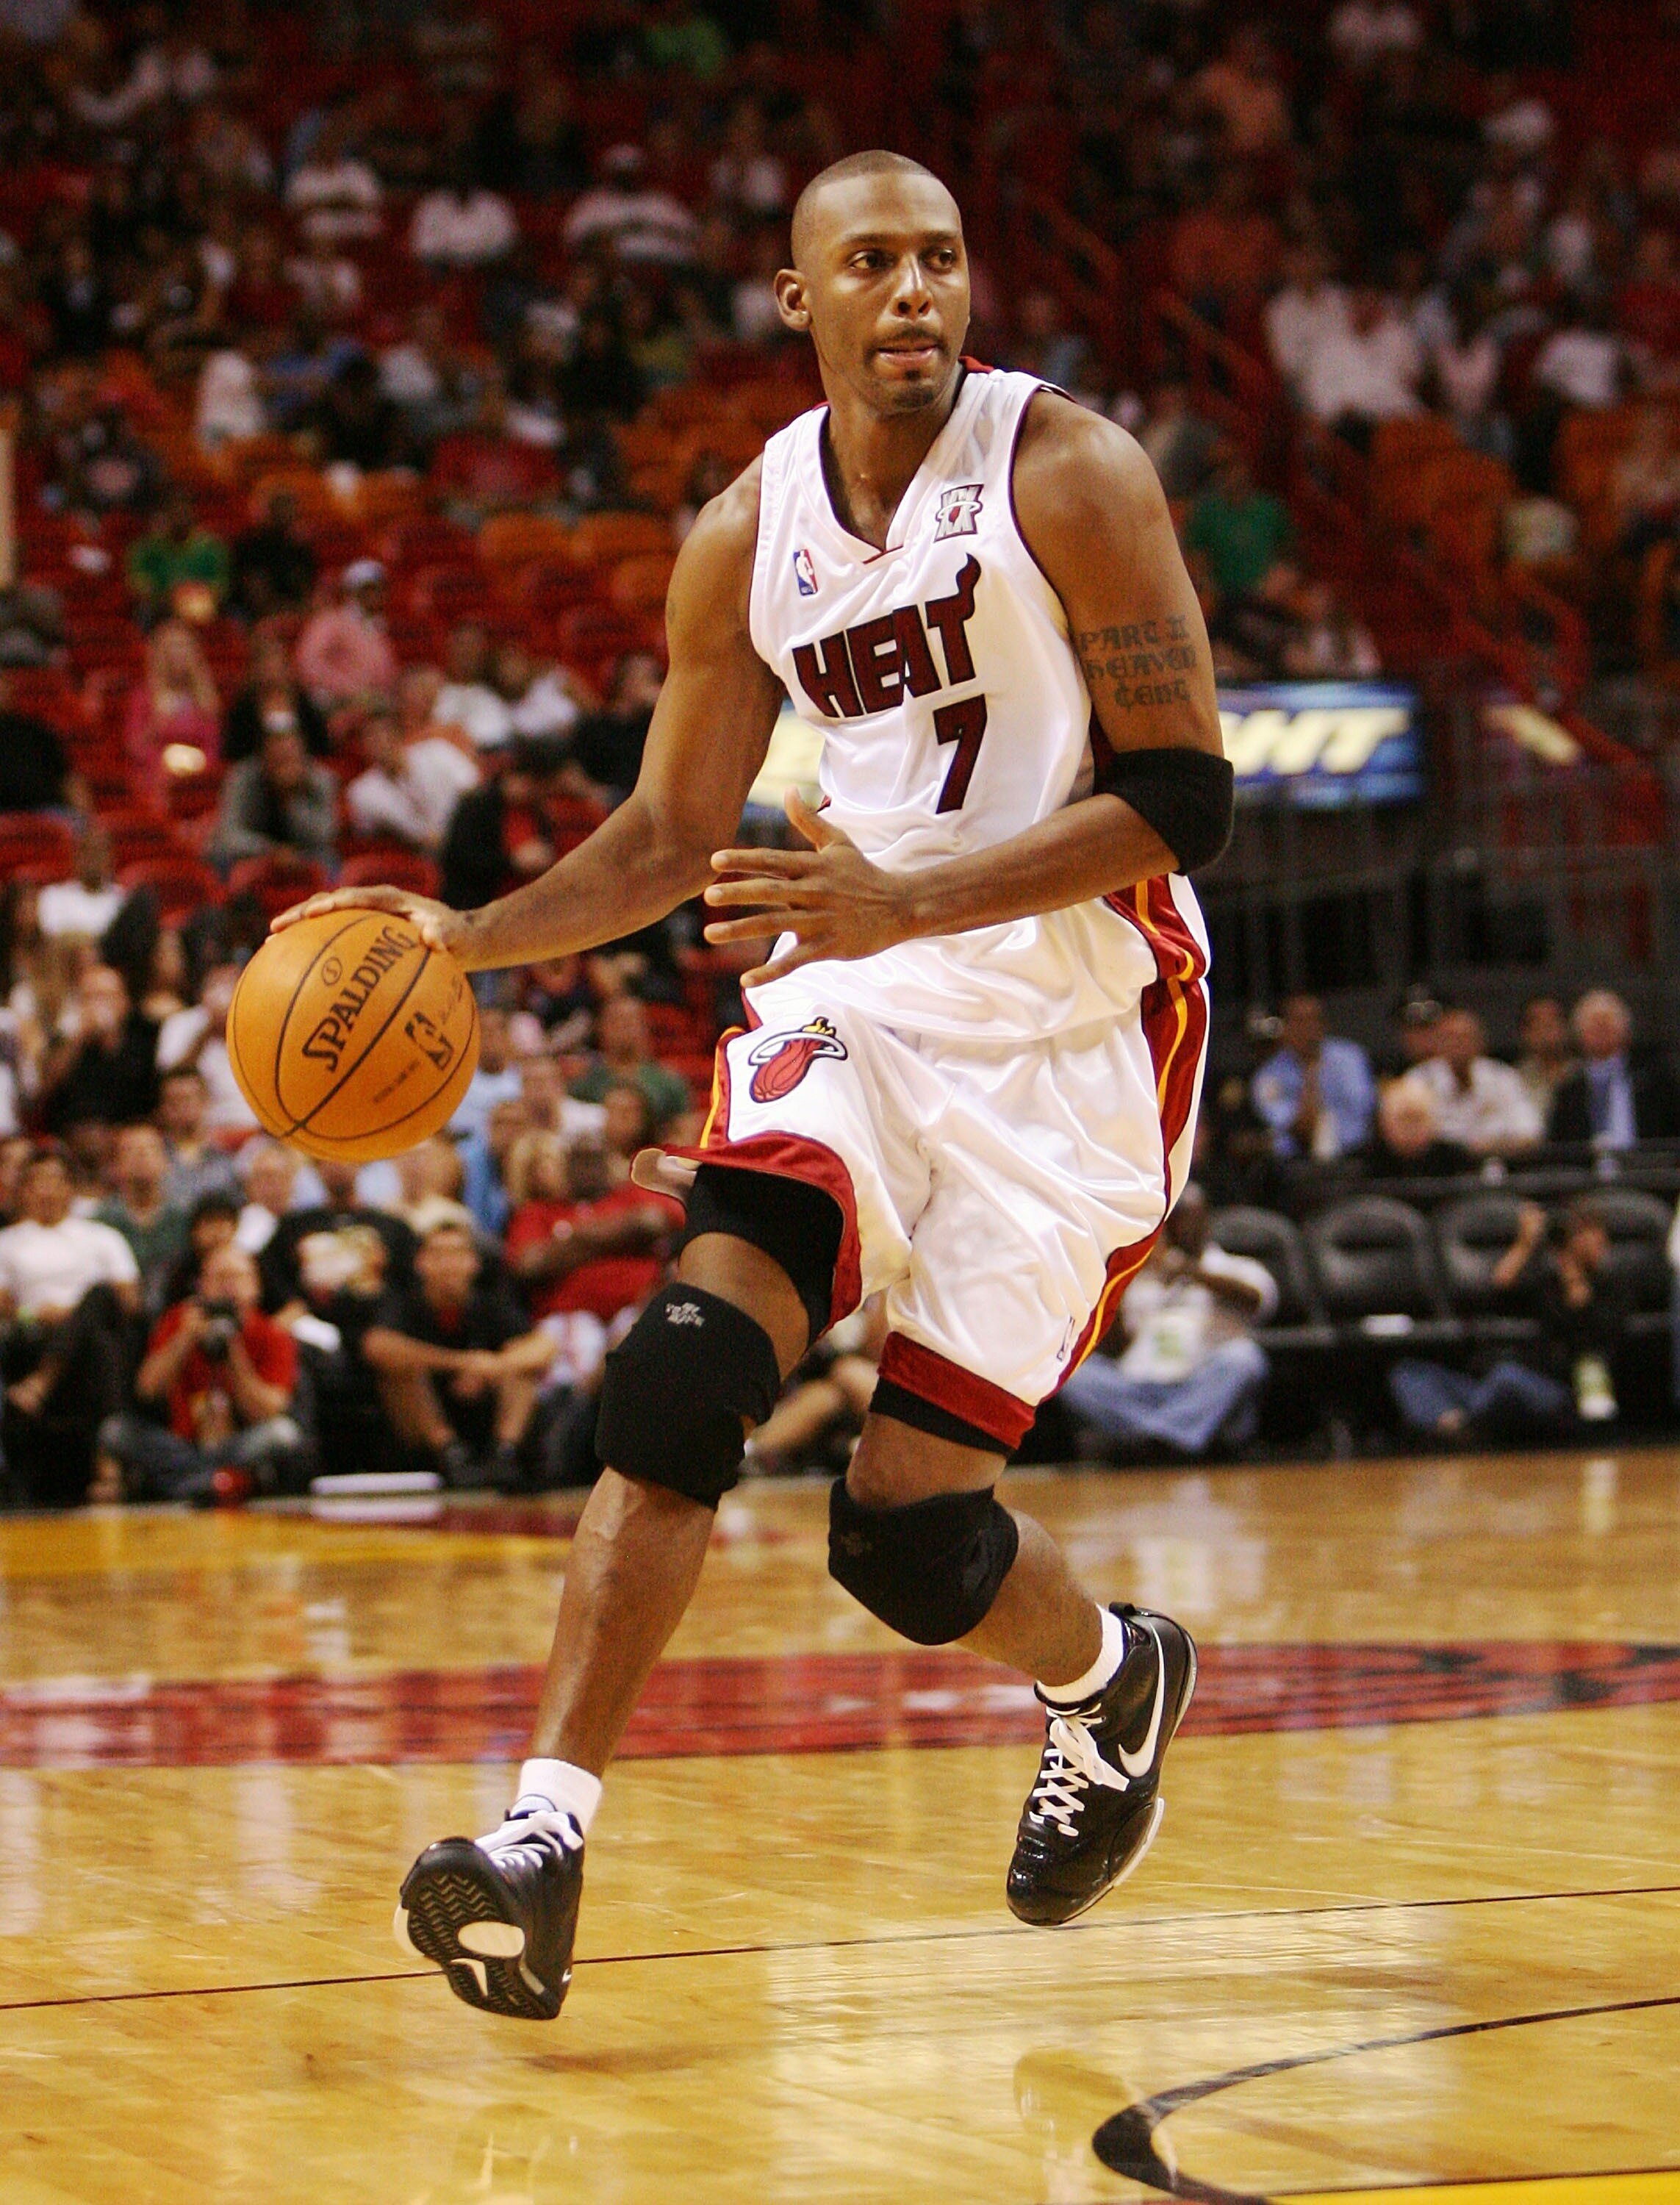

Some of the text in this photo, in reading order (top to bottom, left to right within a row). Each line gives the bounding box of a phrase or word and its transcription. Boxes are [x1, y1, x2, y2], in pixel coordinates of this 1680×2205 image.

[792, 553, 982, 718] HEAT
[933, 694, 988, 814] 7
[301, 925, 417, 1073] SPALDING
